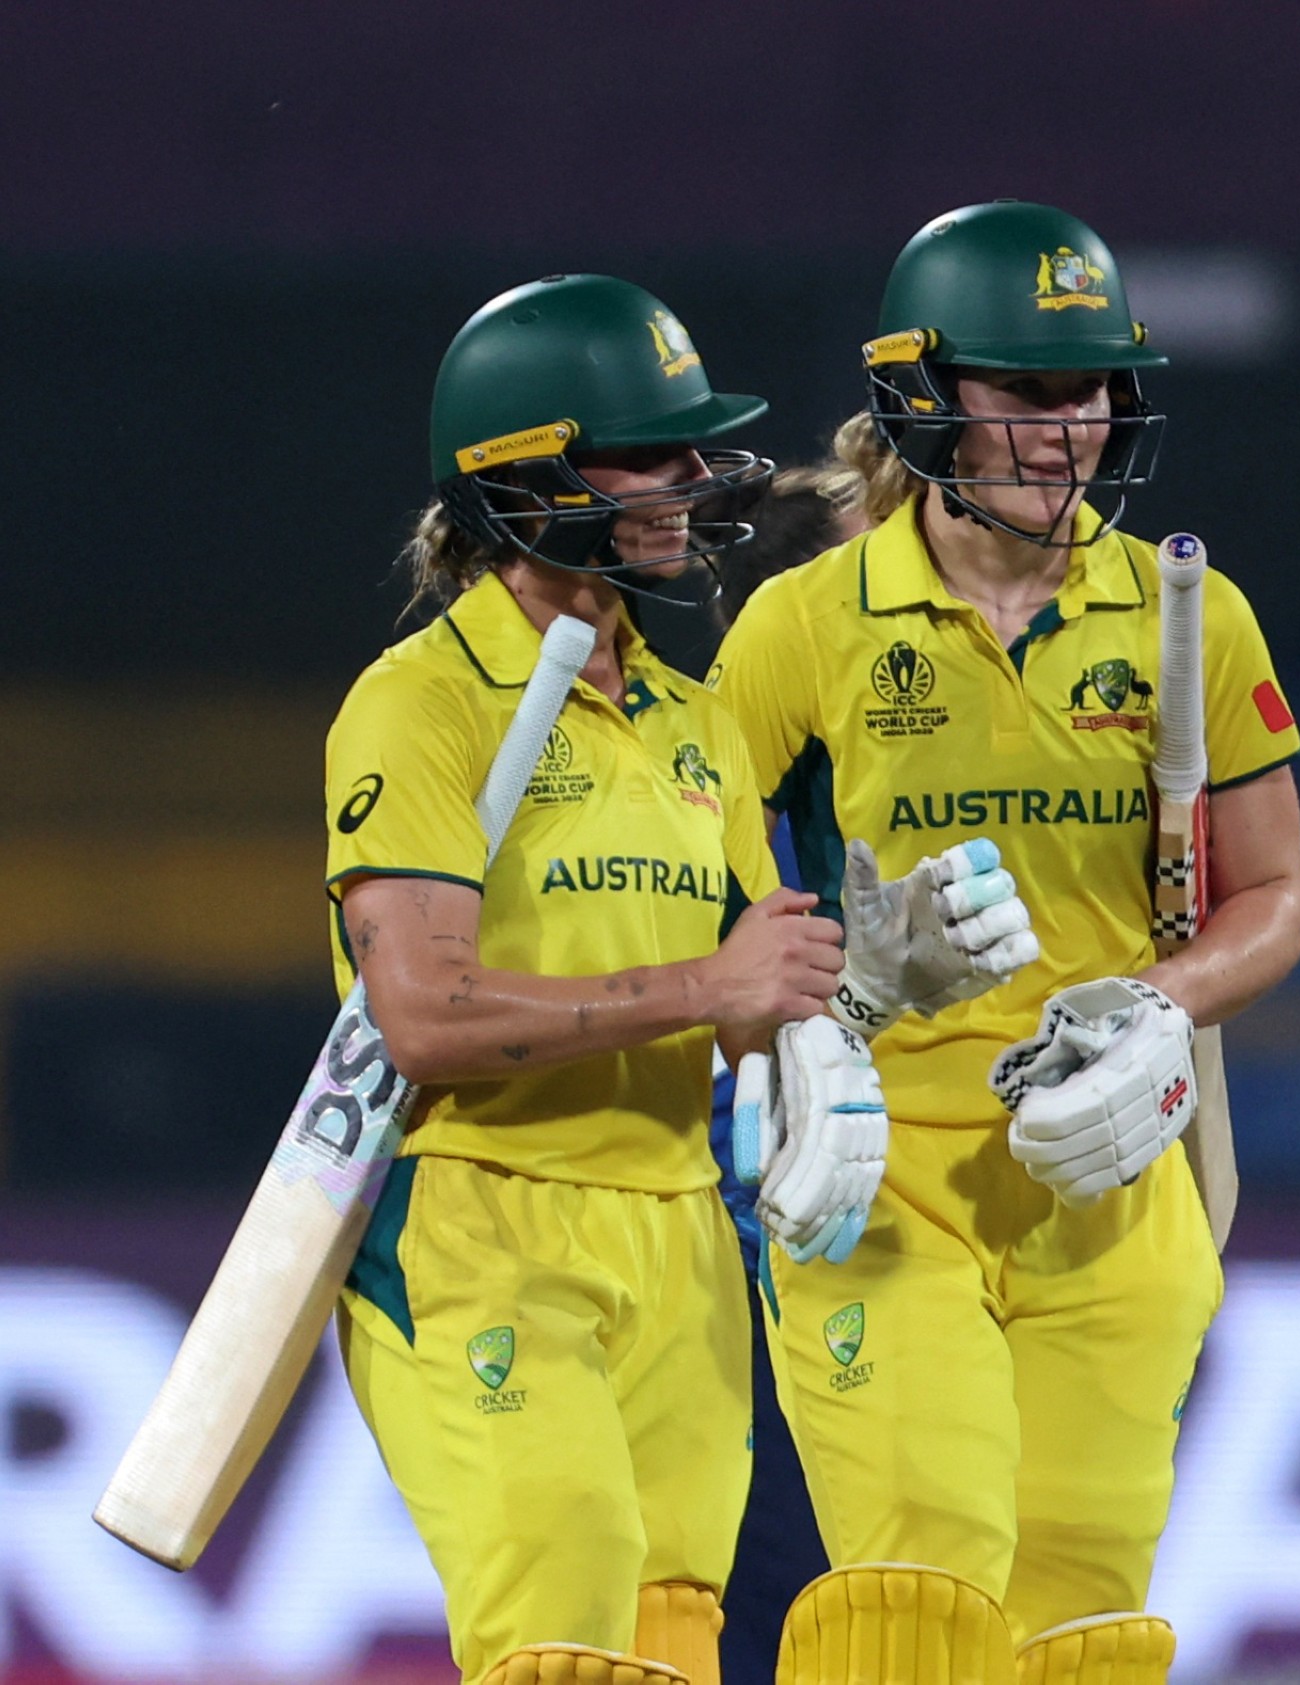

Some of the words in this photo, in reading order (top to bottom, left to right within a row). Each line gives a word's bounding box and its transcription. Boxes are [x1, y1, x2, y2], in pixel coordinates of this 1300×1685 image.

[489, 431, 550, 455] MASURI
[893, 695, 917, 706] ICC
[909, 706, 947, 715] CRICKET
[865, 716, 917, 729] WORLD
[920, 714, 949, 727] CUP
[544, 761, 564, 773] ICC
[524, 782, 567, 797] ORLD
[569, 781, 594, 793] CUP
[889, 786, 1148, 832] AUSTRALIA
[836, 983, 890, 1027] DSC
[829, 1361, 875, 1388] CRICKET
[474, 1390, 528, 1409] CRICKET
